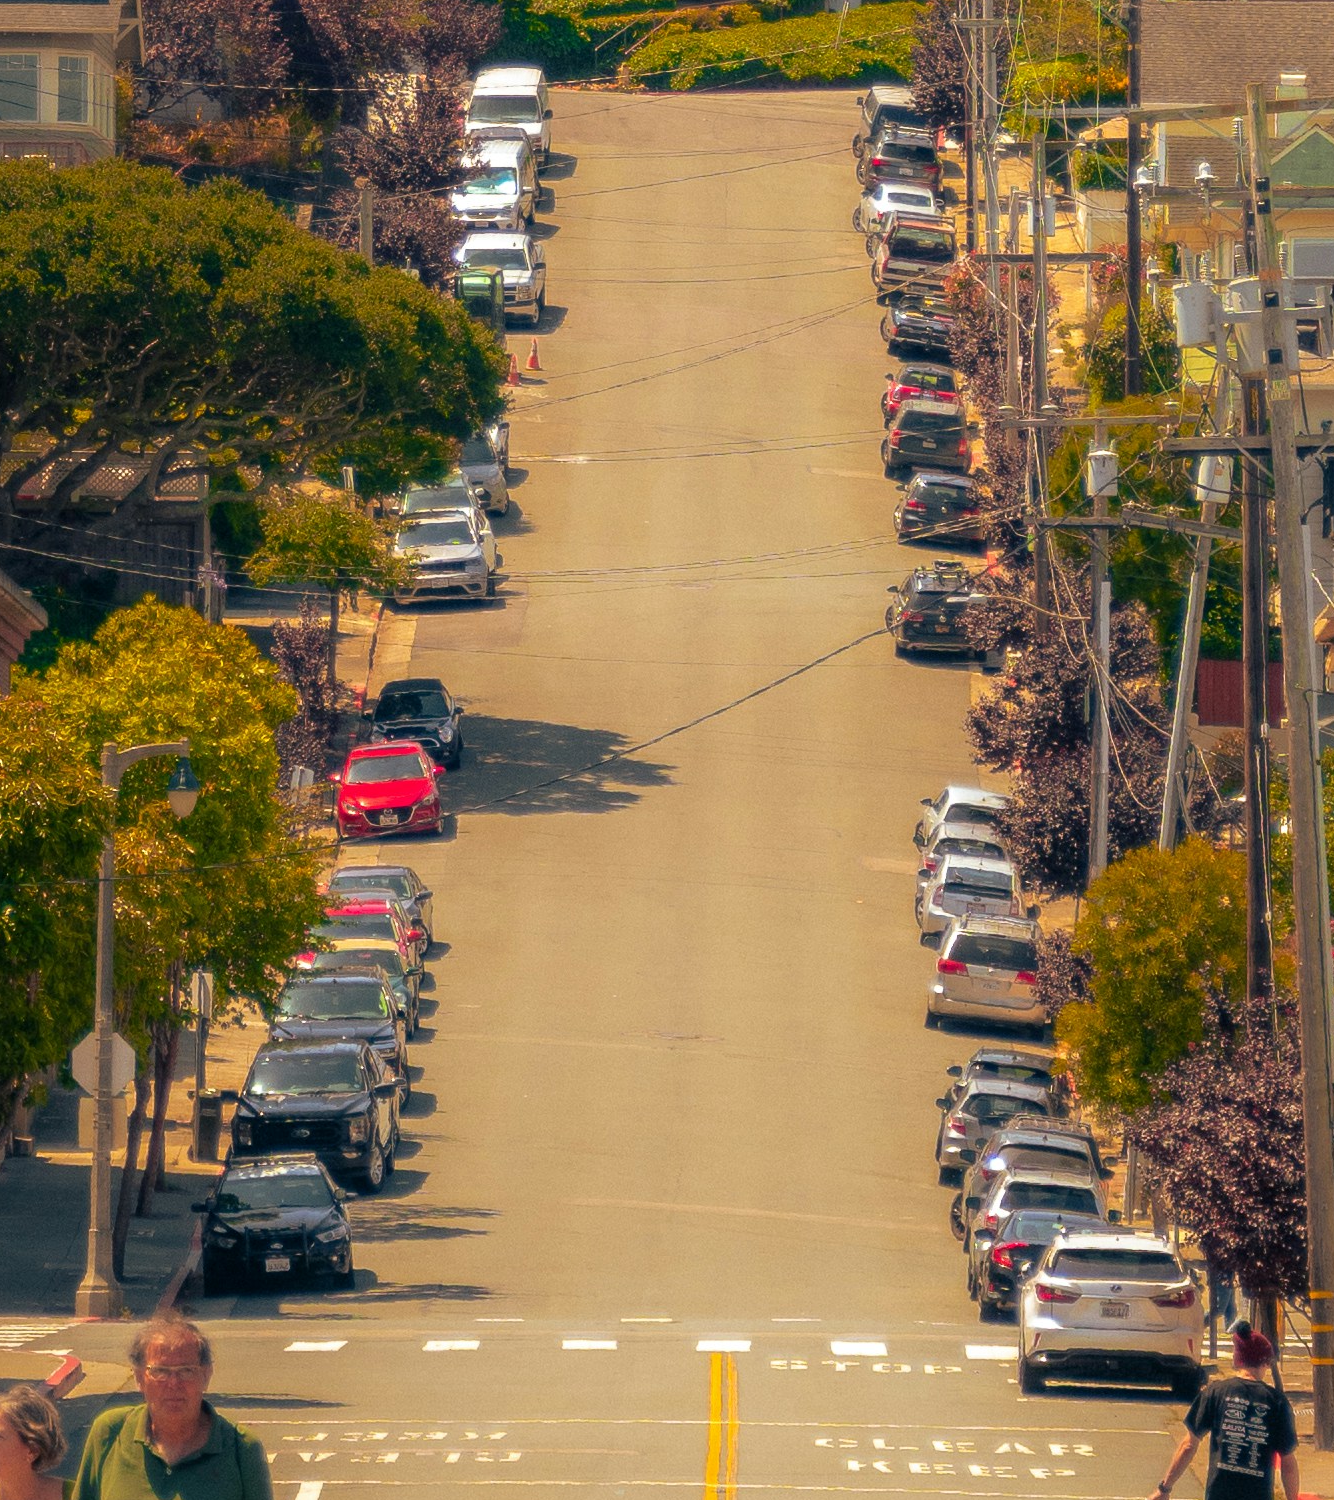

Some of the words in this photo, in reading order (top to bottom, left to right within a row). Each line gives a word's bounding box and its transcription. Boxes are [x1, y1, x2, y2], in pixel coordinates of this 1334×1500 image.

[769, 1359, 963, 1375] STOP
[814, 1437, 1098, 1458] CLEAR
[846, 1458, 1077, 1480] KEEP
